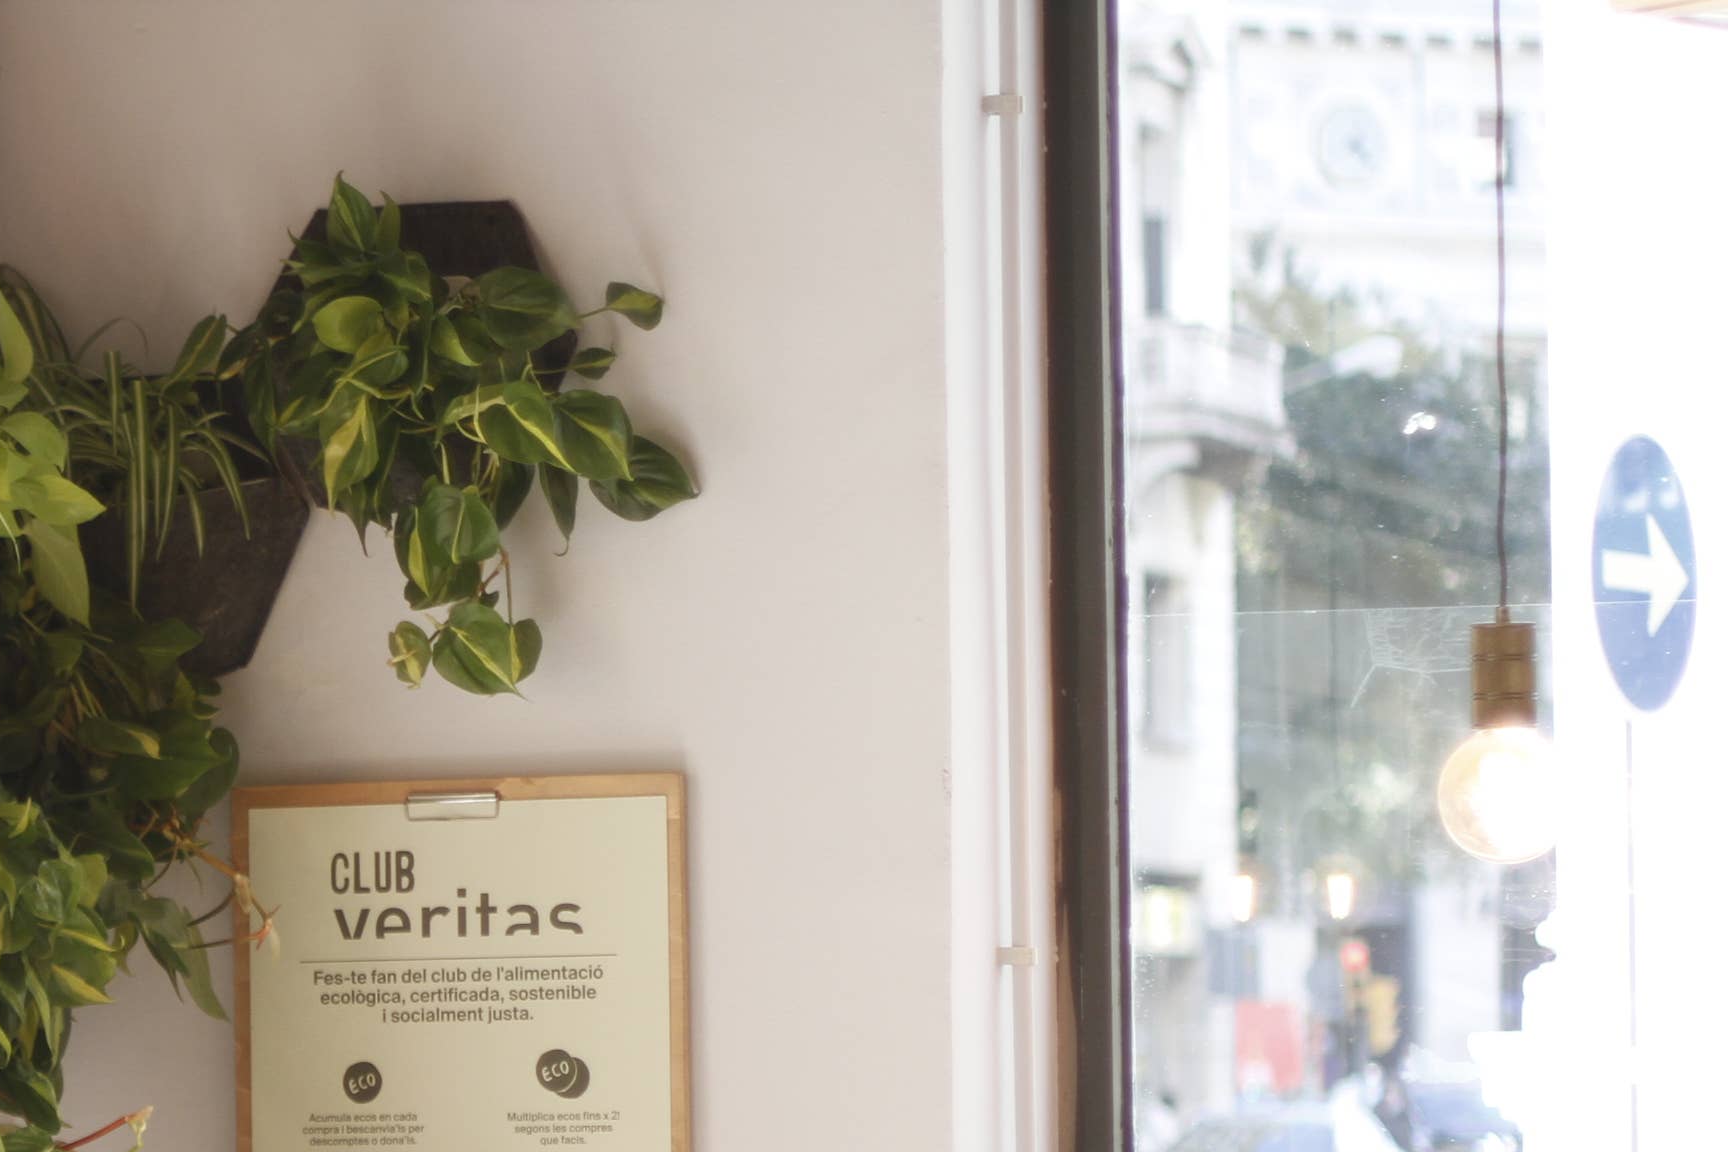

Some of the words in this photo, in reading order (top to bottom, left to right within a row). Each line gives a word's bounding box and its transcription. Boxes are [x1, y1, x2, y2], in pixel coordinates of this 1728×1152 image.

[330, 850, 416, 895] CLUB
[333, 888, 584, 940] veritas
[313, 970, 367, 986] Fes-te
[371, 969, 397, 985] fan
[401, 968, 427, 984] del
[431, 967, 467, 983] club
[471, 967, 492, 982] de
[496, 965, 604, 981] l'alimentació
[320, 988, 406, 1007] ecològica,
[410, 986, 505, 1004] certificada,
[509, 985, 597, 1001] sostenible
[382, 1008, 387, 1023] i
[391, 1007, 484, 1023] socialment
[487, 1006, 534, 1024] justa.
[540, 1060, 571, 1083] ECO
[347, 1072, 377, 1095] ECO
[353, 1114, 377, 1122] ecos
[379, 1114, 392, 1122] en
[393, 1113, 418, 1121] cada
[557, 1113, 581, 1121] ecos
[583, 1111, 601, 1120] fins
